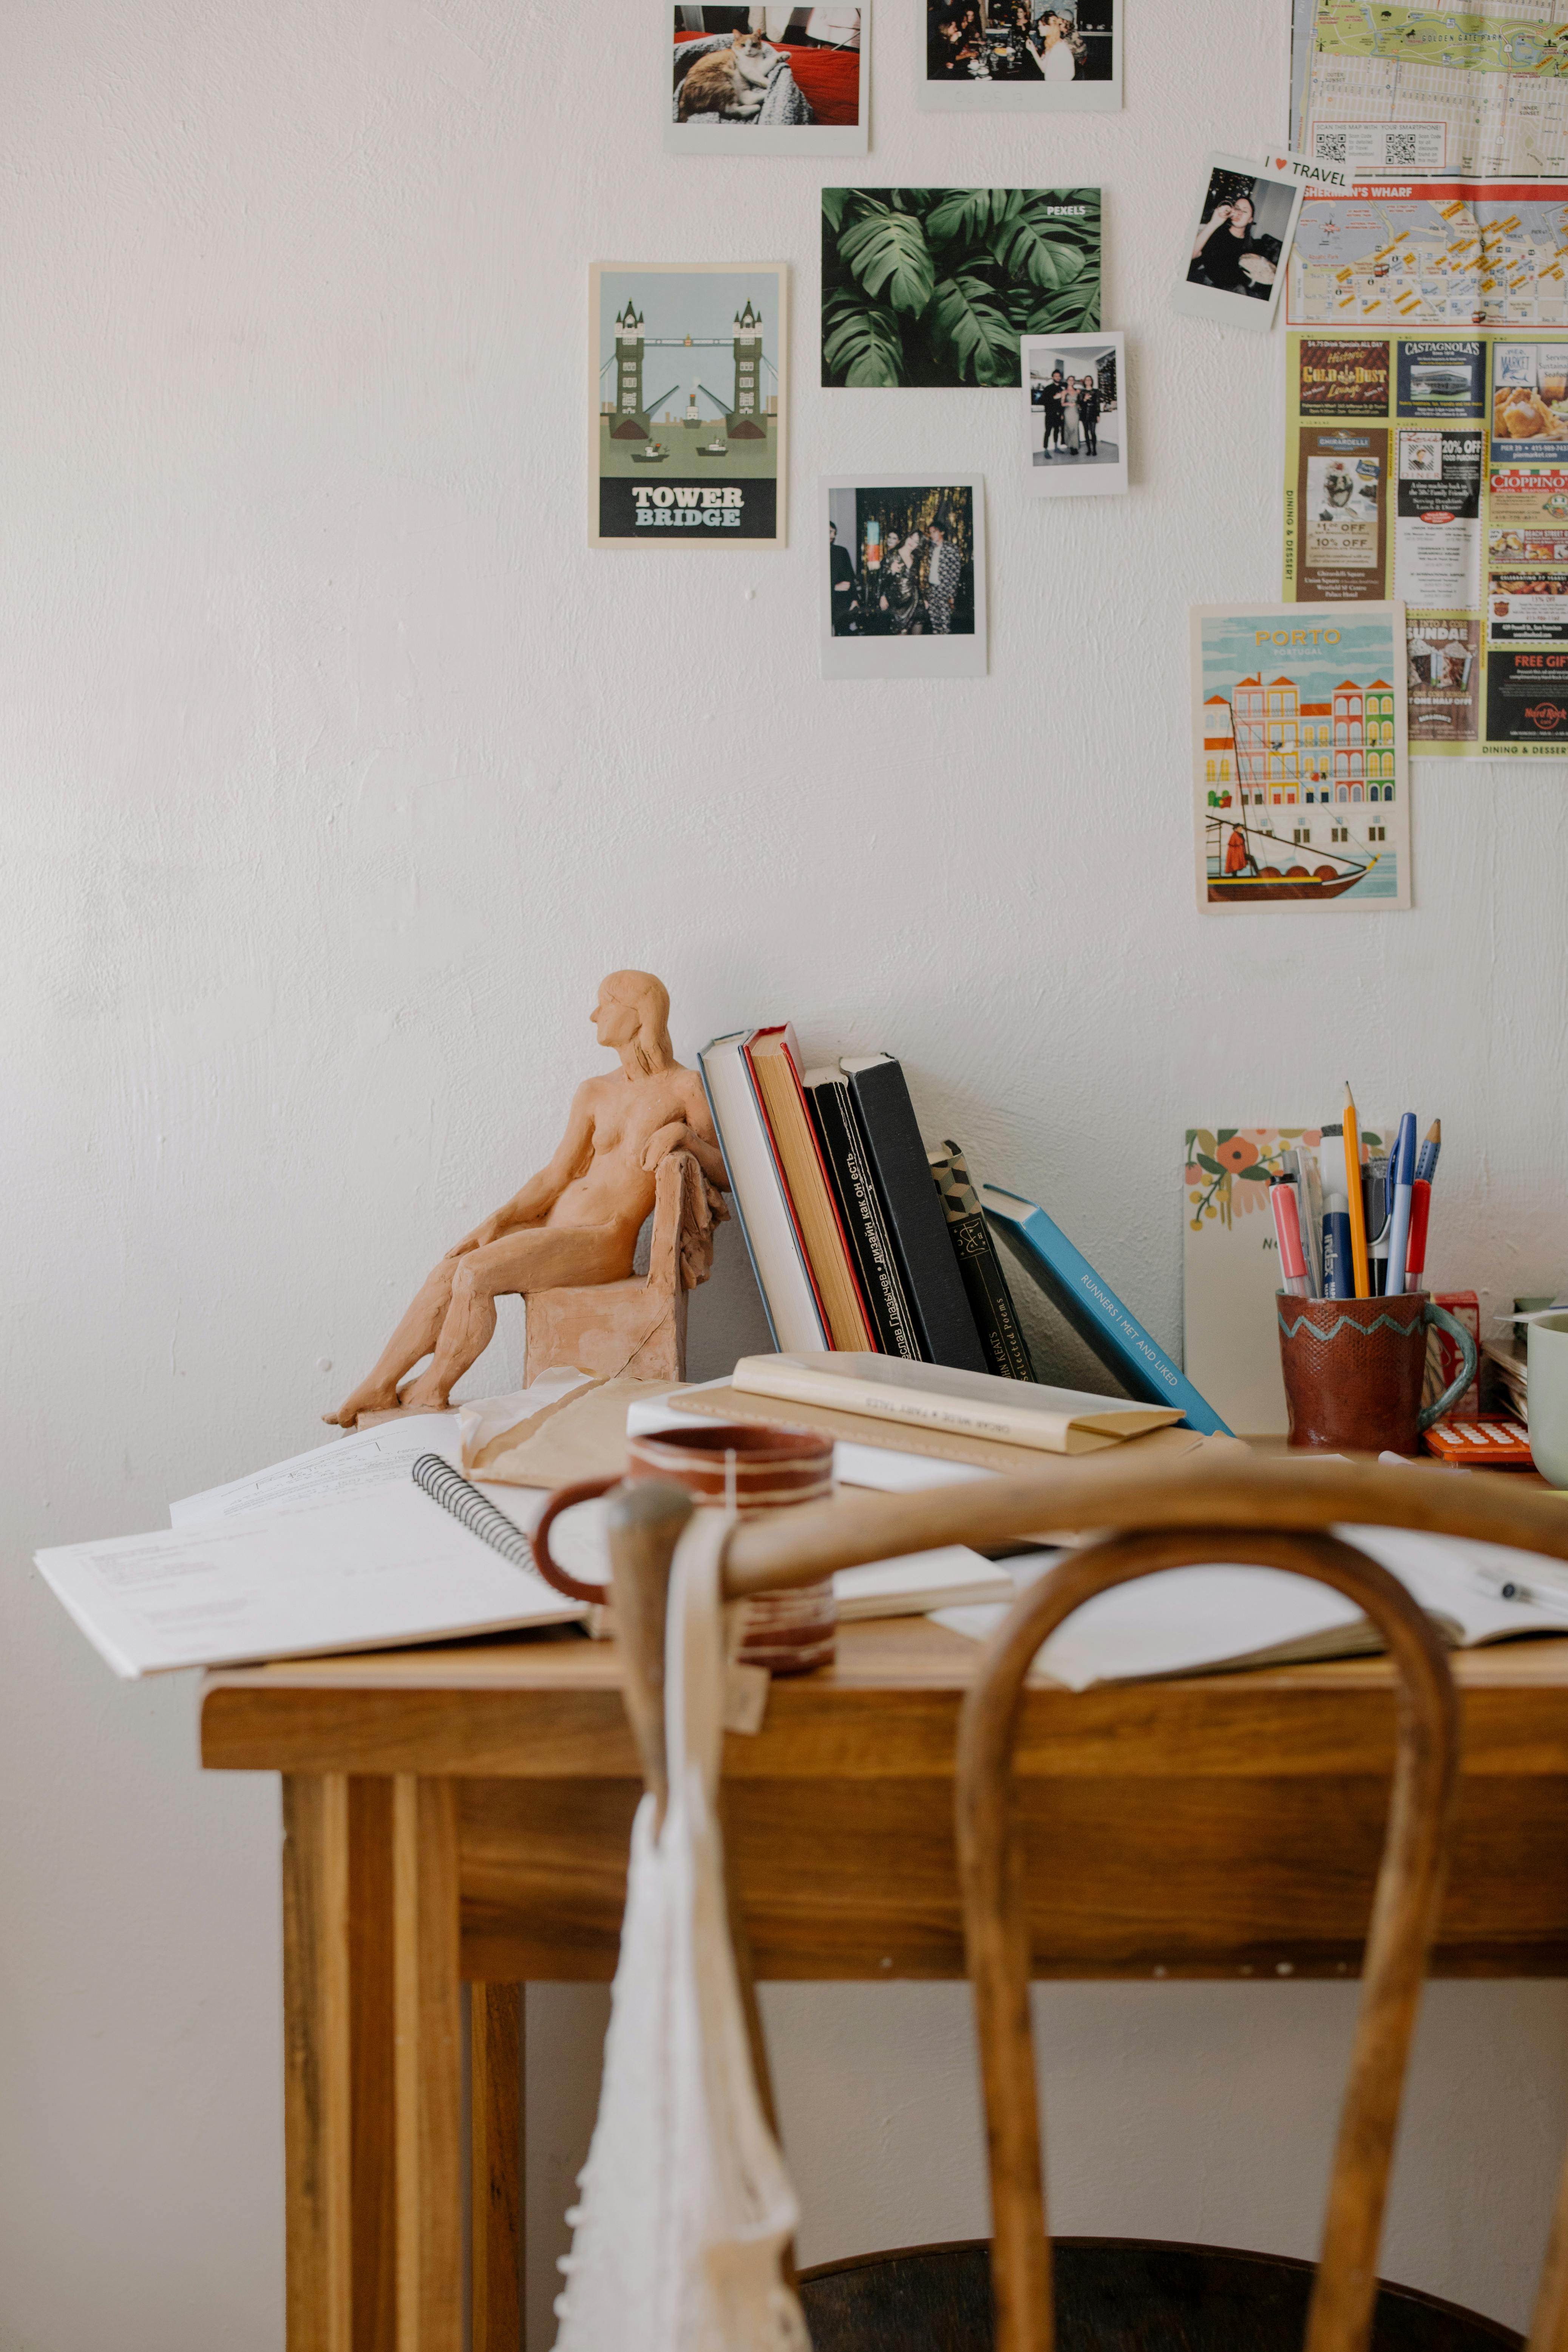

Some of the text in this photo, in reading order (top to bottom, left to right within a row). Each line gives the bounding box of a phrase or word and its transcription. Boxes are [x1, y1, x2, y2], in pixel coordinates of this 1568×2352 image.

[1265, 156, 1346, 187] I TRAVEL
[1304, 187, 1412, 197] SHERN'S WHARF
[1047, 205, 1086, 216] PEXELS
[1404, 342, 1480, 356] CASTAGNOLA'S
[1303, 366, 1387, 383] GOLD DUST
[1327, 384, 1361, 398] Lounge
[1442, 440, 1481, 453] 20% OFF
[632, 486, 745, 508] TOWER
[635, 508, 741, 527] BRIDGE
[1316, 539, 1338, 547] 10%
[1255, 629, 1341, 647] PORTO
[1406, 627, 1469, 641] SUNDAE
[1273, 648, 1323, 656] PORTUGAL
[1514, 655, 1544, 667] FREE
[1532, 746, 1568, 755] DESSER
[846, 1153, 859, 1180] есть
[853, 1183, 864, 1198] он
[858, 1200, 870, 1220] как
[864, 1221, 883, 1264] дизайн
[1081, 1274, 1118, 1317] RUNNERS
[1120, 1320, 1139, 1339] MET
[1136, 1340, 1156, 1361] AND
[1154, 1360, 1178, 1386] LIKED
[894, 1328, 909, 1360] еслав
[989, 1331, 1012, 1379] OHN KEATS
